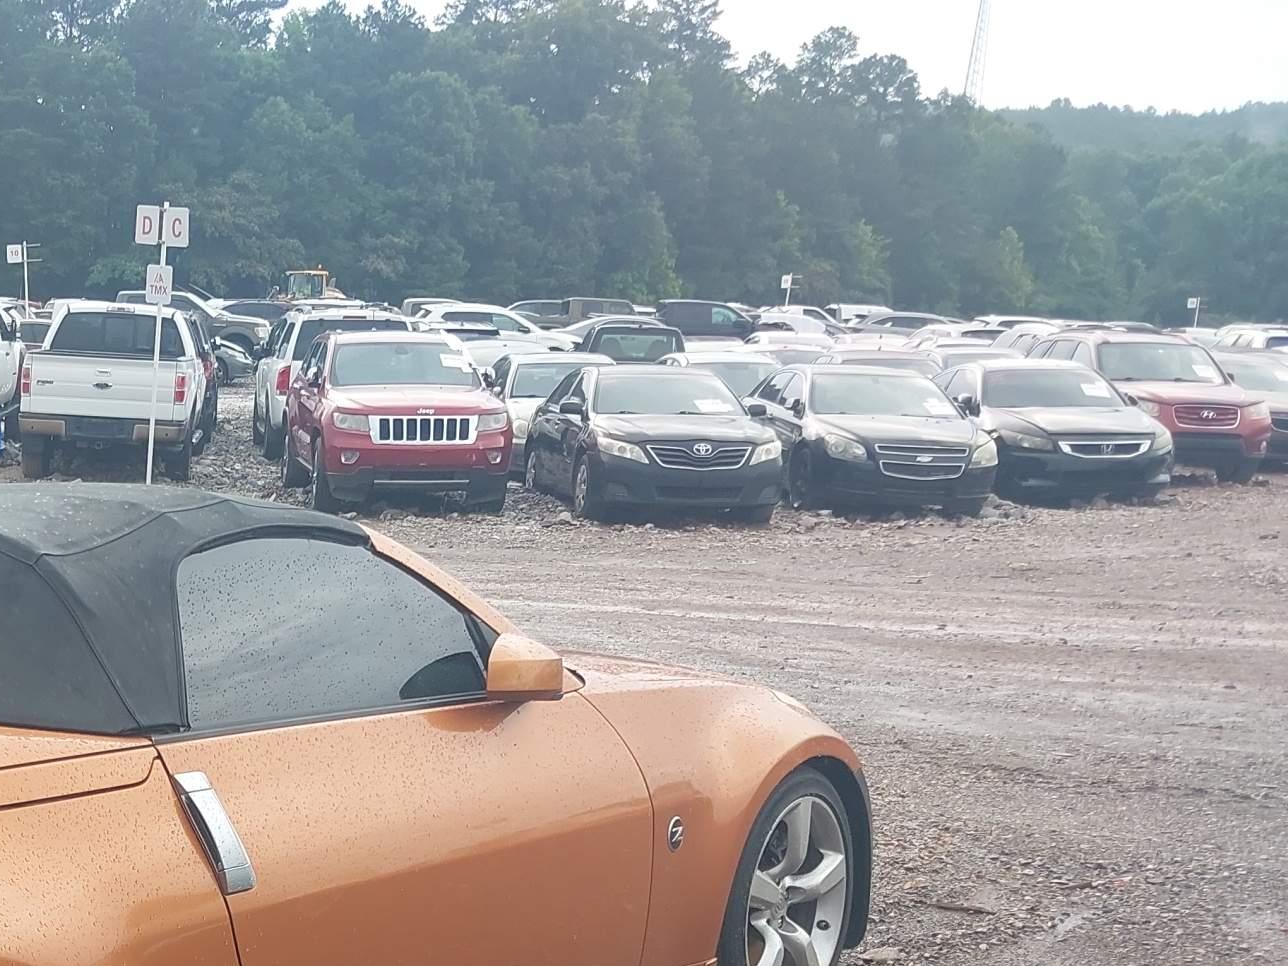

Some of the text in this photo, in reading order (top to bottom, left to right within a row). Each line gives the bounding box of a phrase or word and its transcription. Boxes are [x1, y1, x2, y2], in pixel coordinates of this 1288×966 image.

[142, 216, 152, 235] D
[172, 217, 182, 238] C
[416, 407, 435, 415] Jeep
